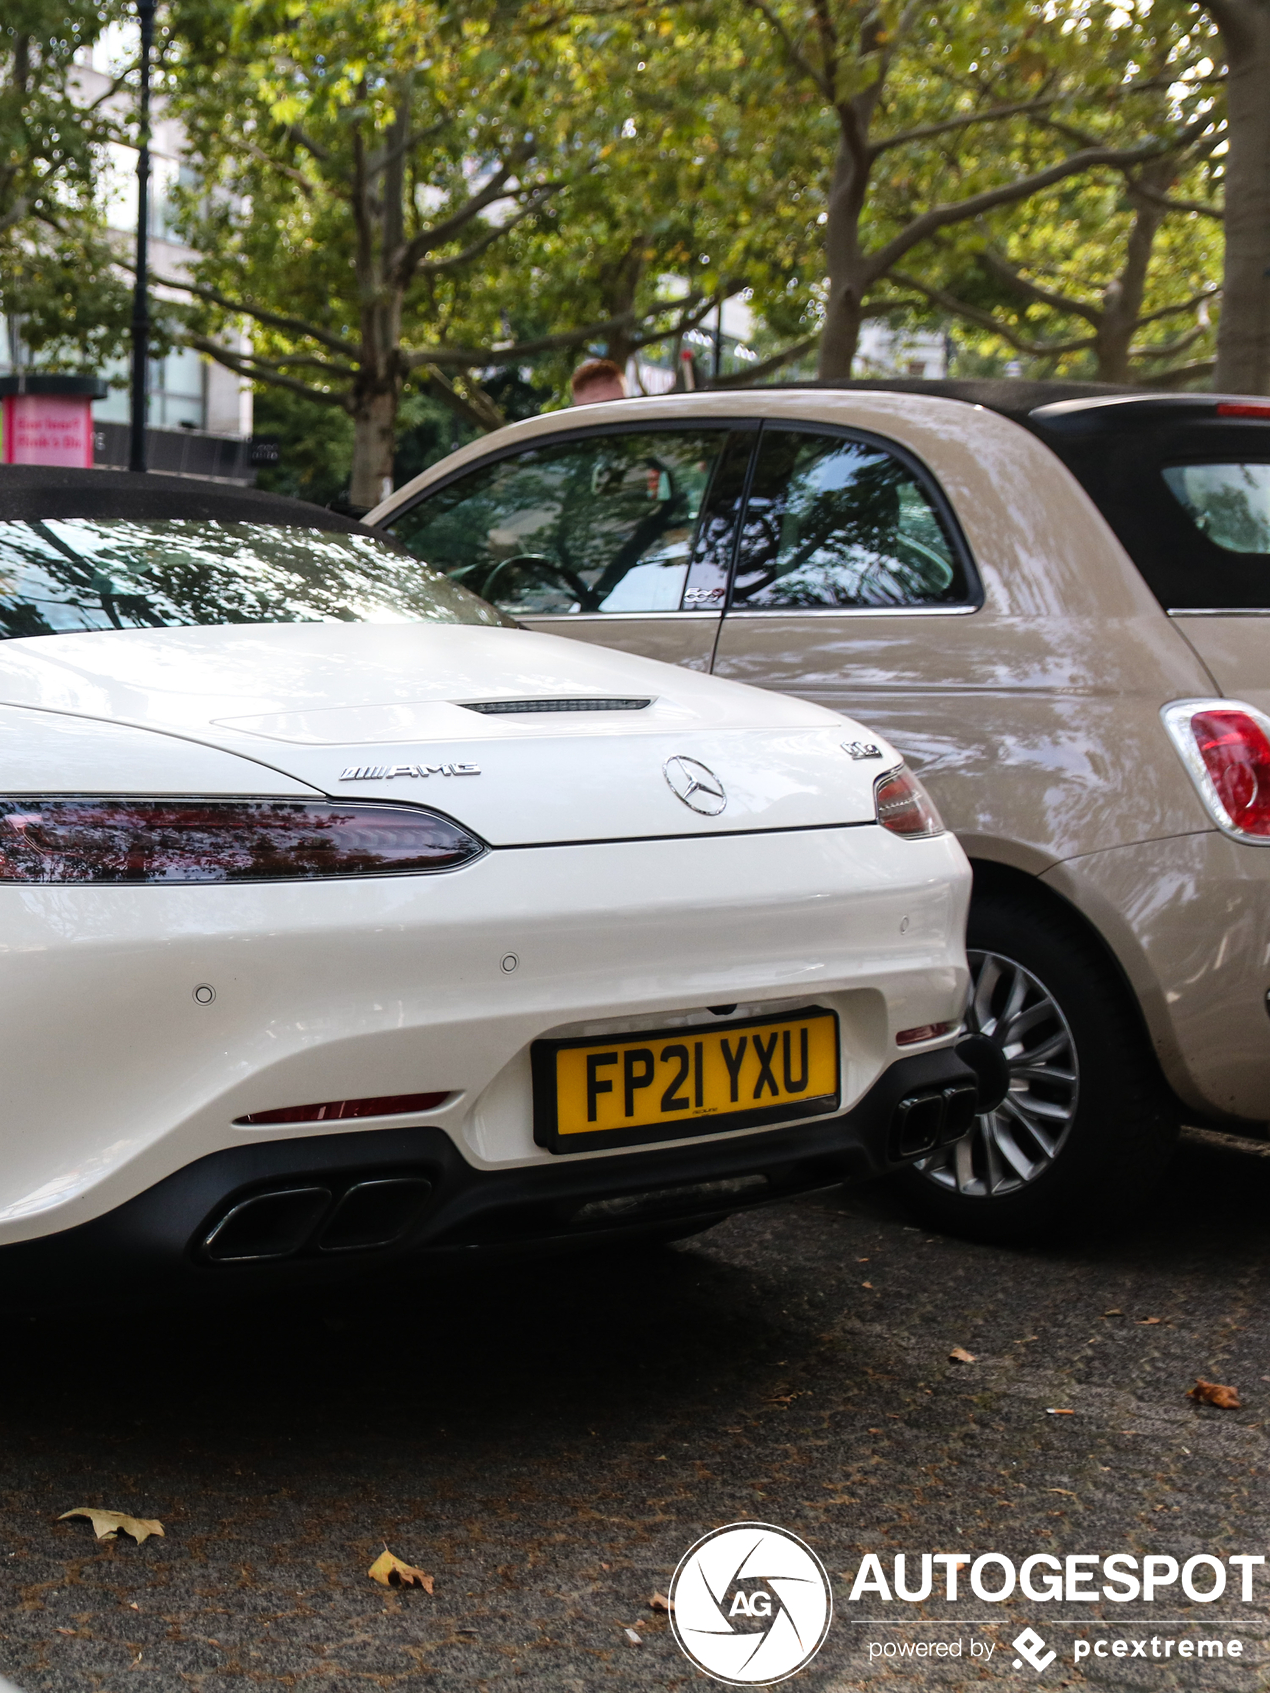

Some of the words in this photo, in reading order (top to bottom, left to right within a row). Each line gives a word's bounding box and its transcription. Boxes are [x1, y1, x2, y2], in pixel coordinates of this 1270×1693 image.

[385, 761, 482, 780] AMG
[586, 1041, 704, 1123] FP21
[720, 1027, 809, 1104] YXU
